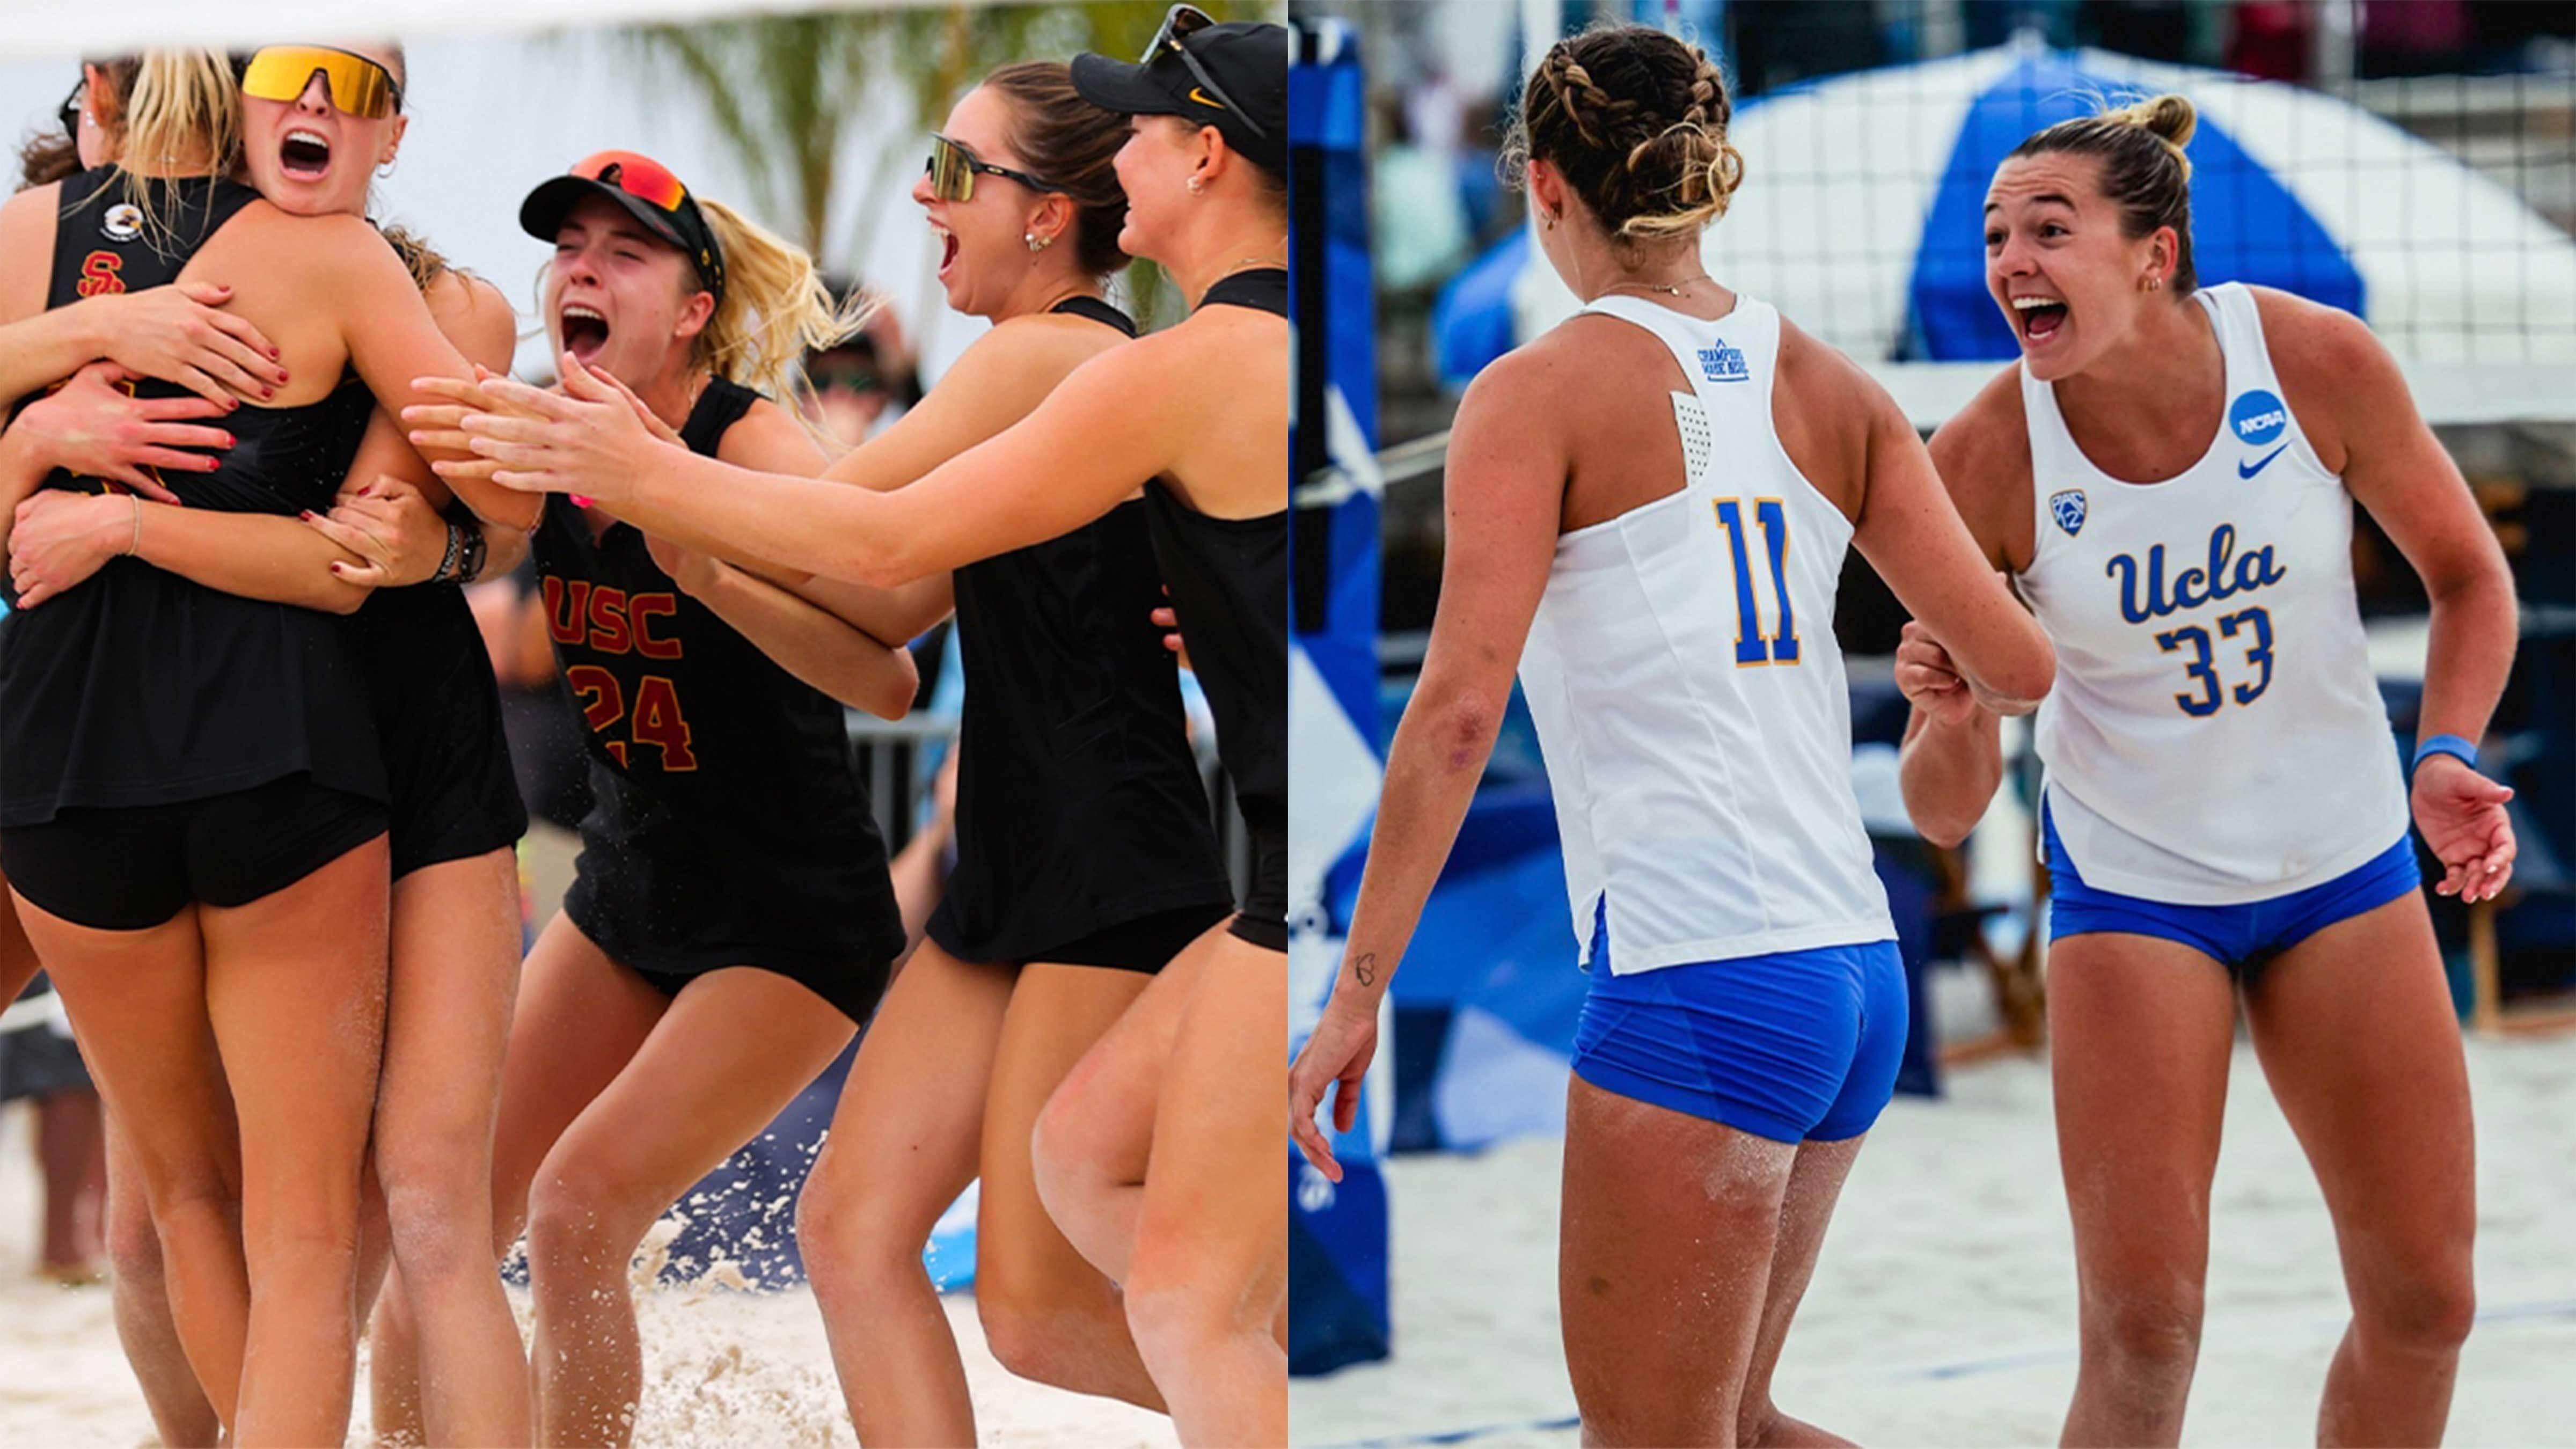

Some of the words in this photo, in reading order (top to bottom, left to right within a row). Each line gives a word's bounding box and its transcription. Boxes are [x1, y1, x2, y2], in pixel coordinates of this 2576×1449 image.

[2240, 409, 2285, 435] NCAA
[543, 575, 683, 660] USC
[1712, 496, 1801, 668] 11
[2106, 522, 2287, 625] Ucla
[2153, 606, 2275, 719] 33
[566, 665, 697, 771] 24
